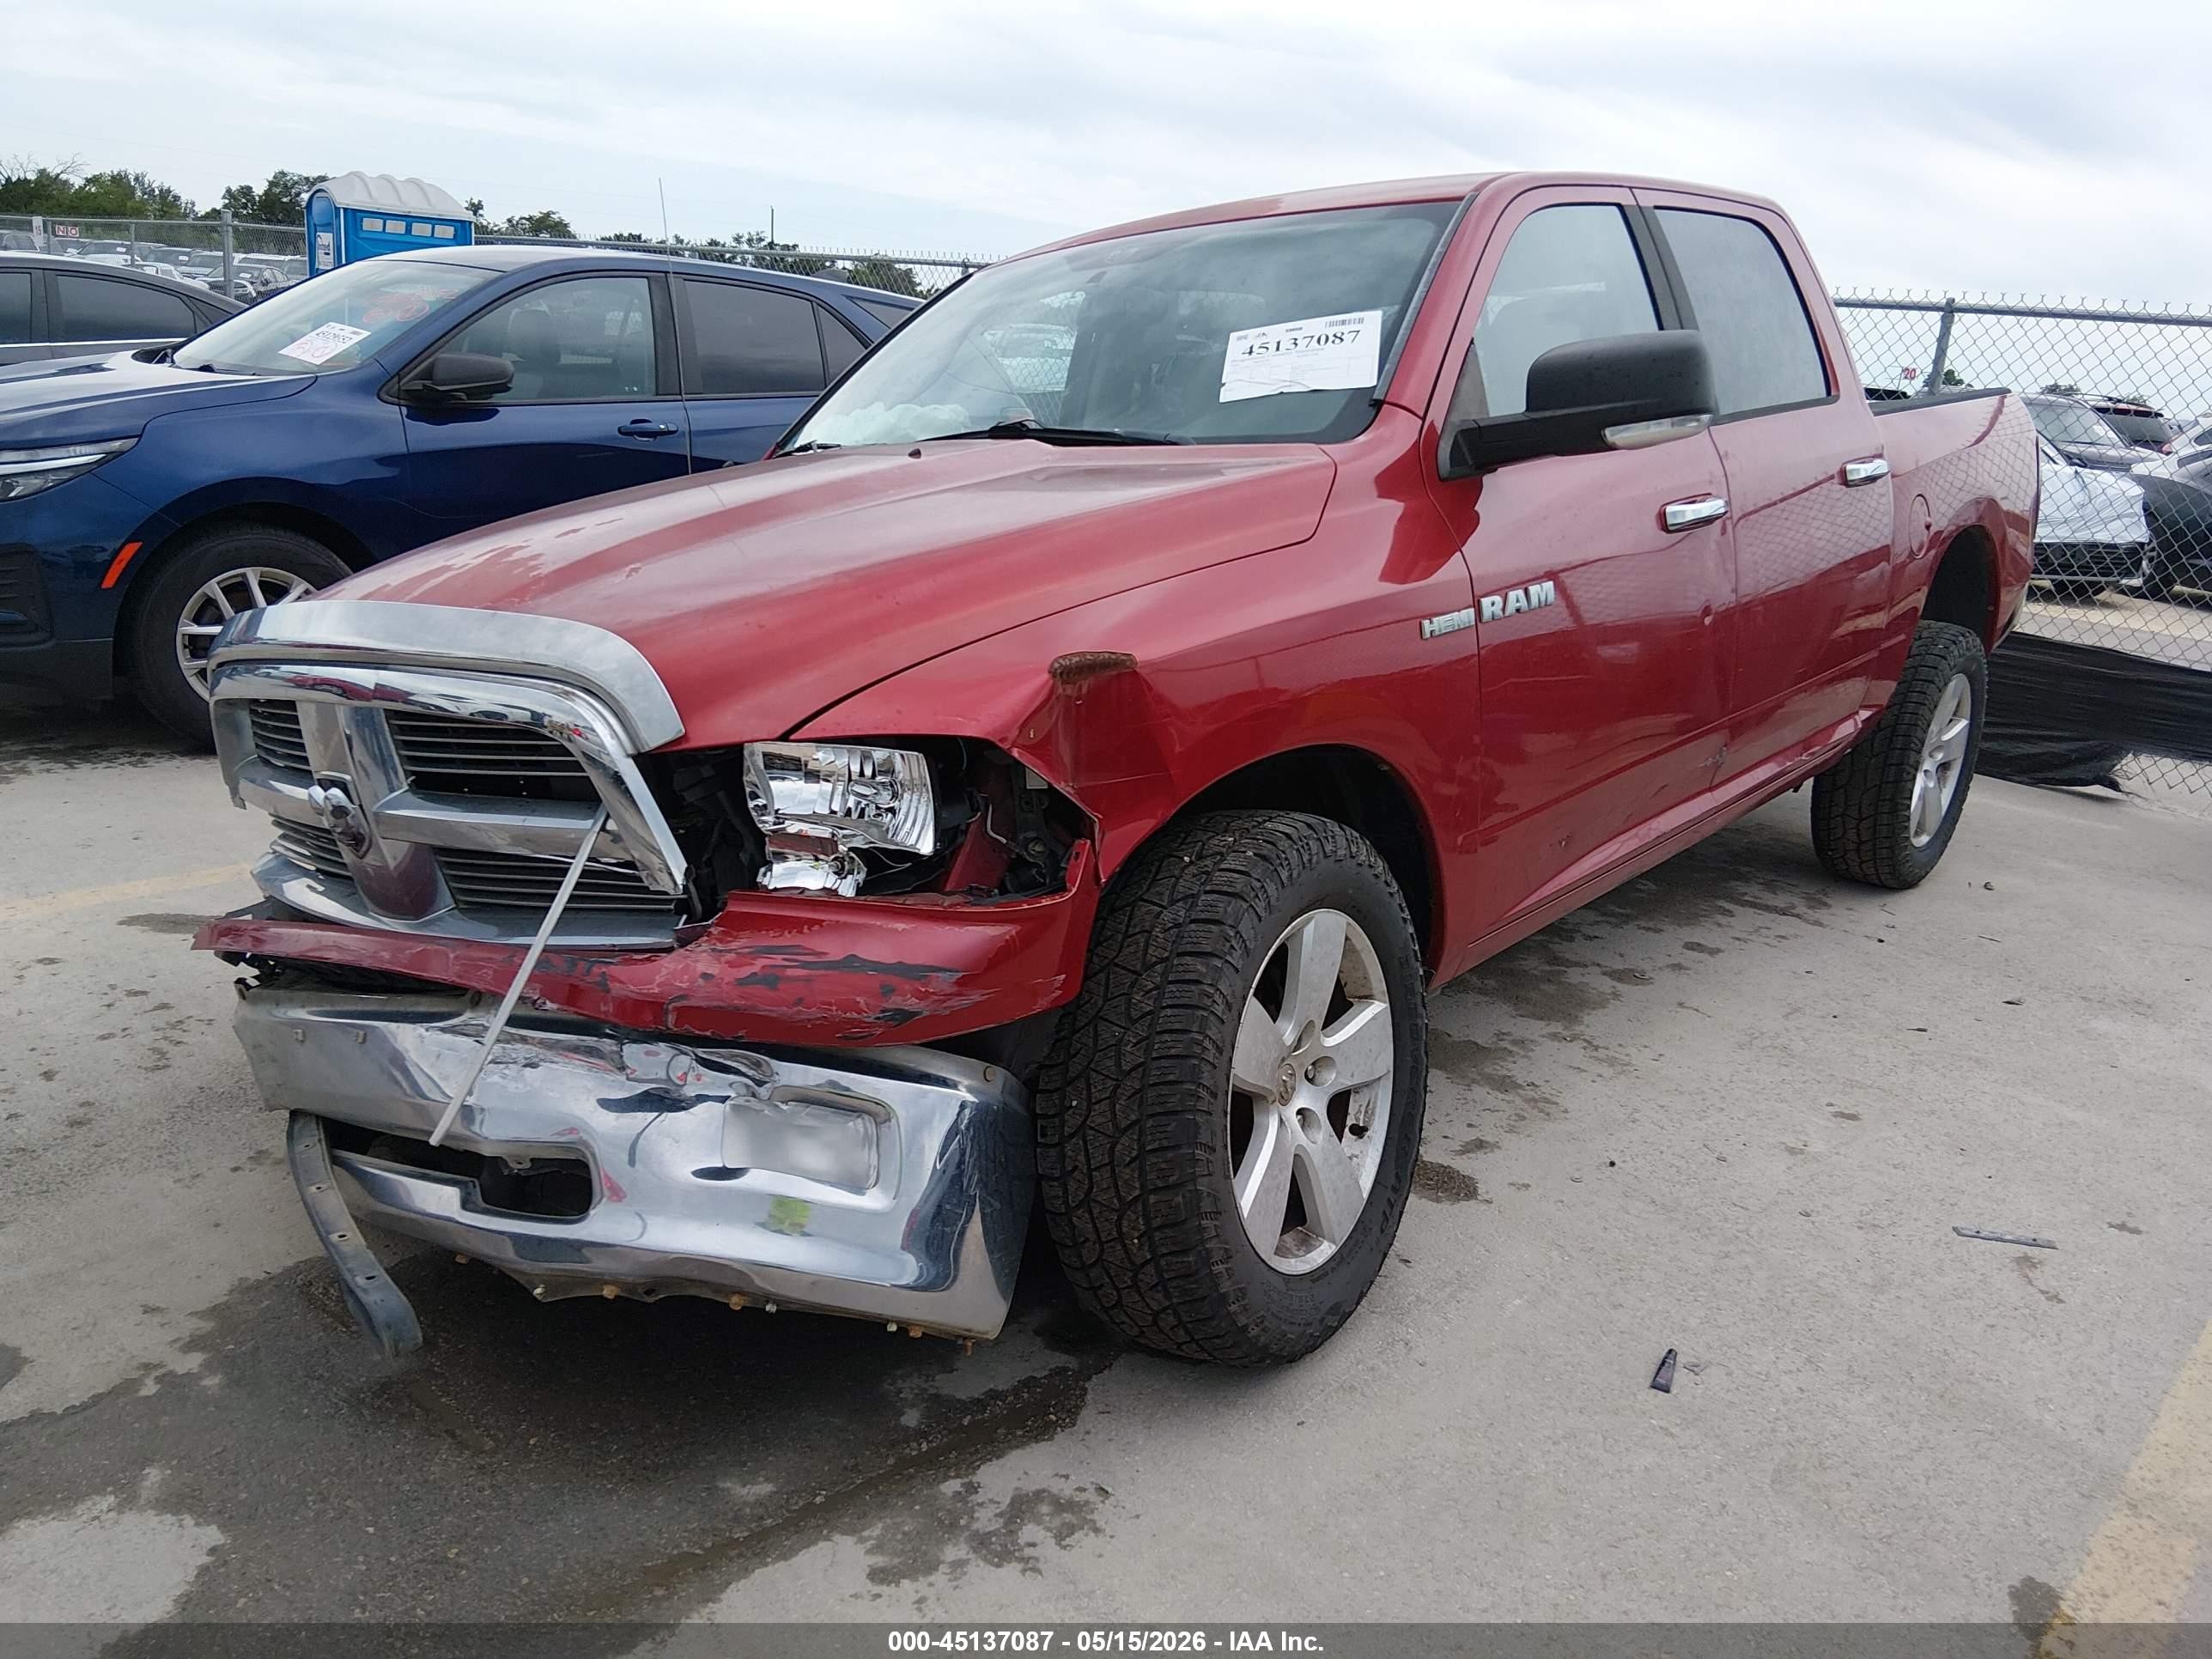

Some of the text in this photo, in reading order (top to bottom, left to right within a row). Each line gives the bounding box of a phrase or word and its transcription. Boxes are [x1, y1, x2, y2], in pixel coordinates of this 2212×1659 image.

[1241, 329, 1361, 356] 45137087
[1479, 580, 1556, 623] RAM
[1421, 607, 1476, 640] HEMI
